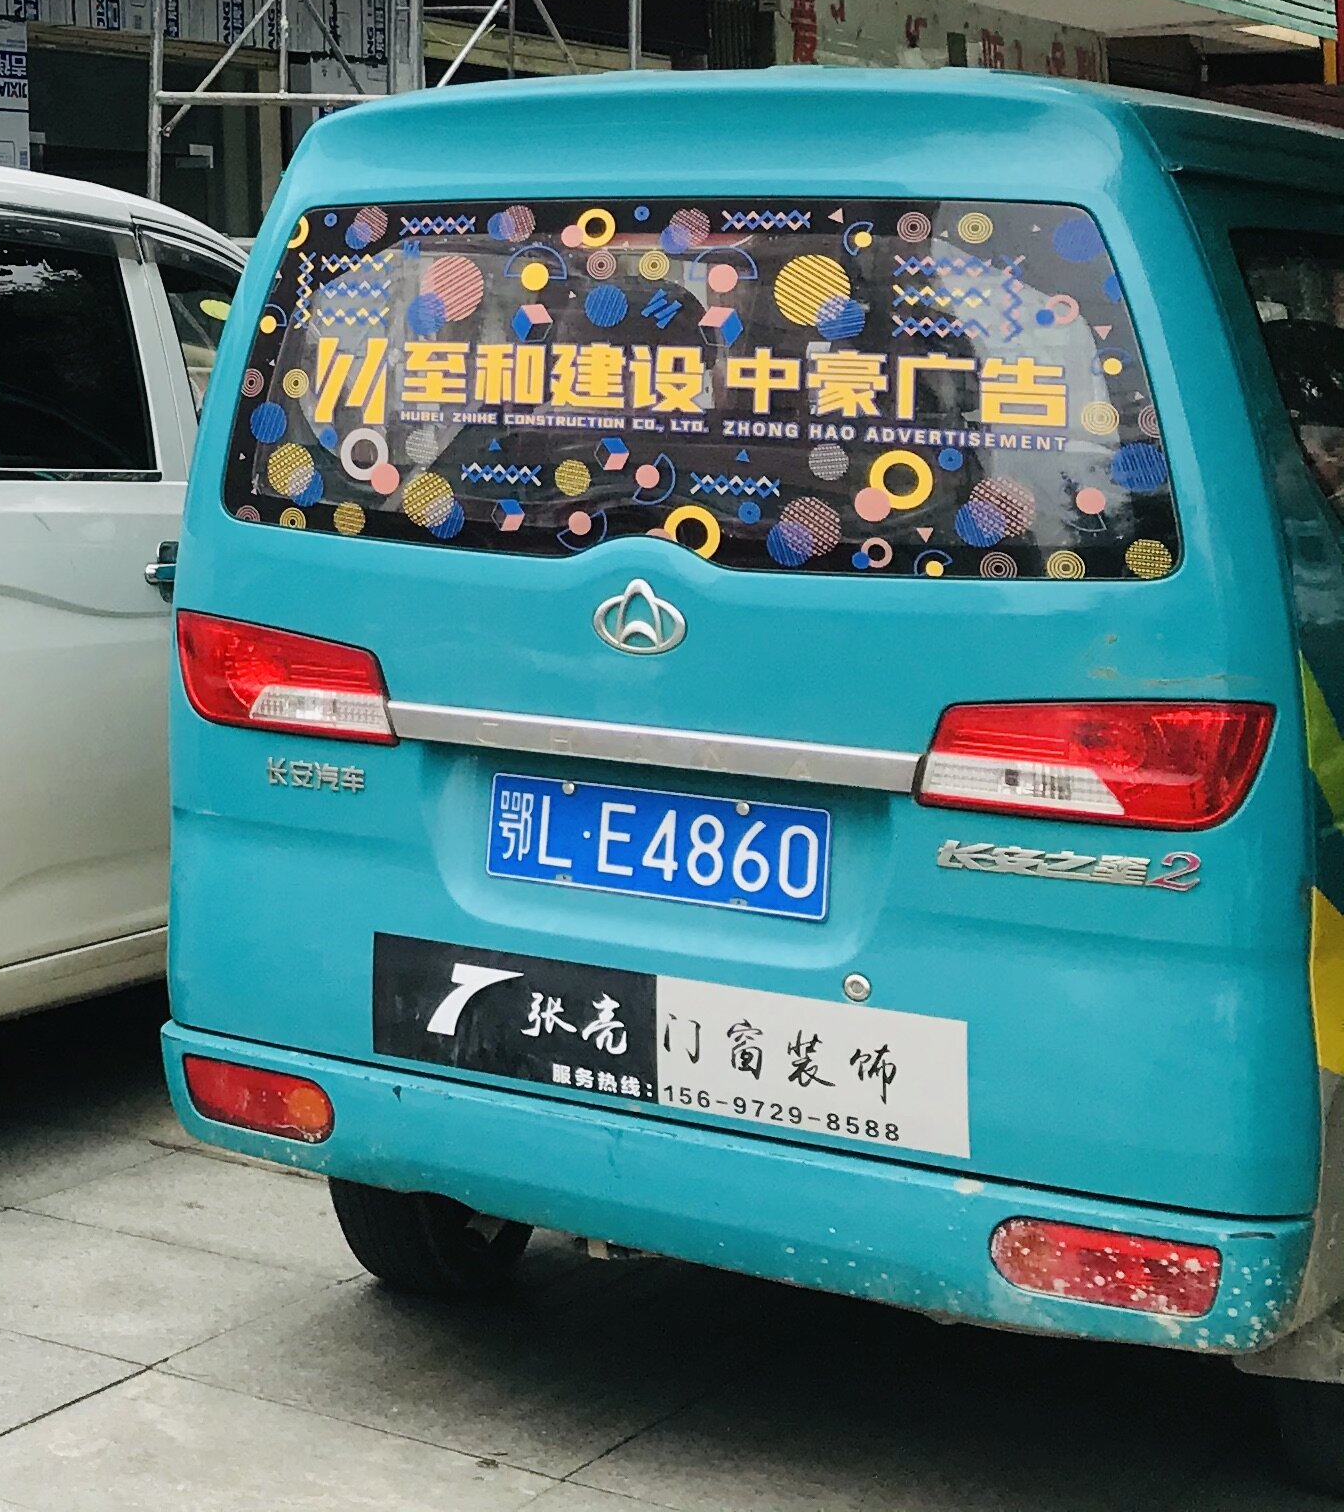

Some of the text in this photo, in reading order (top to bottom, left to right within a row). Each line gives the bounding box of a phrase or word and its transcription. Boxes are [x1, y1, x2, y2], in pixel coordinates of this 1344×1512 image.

[400, 341, 1067, 427] 至和建设 中豪广告
[400, 410, 444, 423] HUBEI
[452, 411, 497, 426] ZHIHE
[504, 413, 626, 430] CONSTRUCTION
[722, 419, 1067, 451] ZHONG HAO ADVERTISEMENT
[265, 756, 366, 794] 长安汽车
[520, 991, 629, 1056] 张亮
[662, 1013, 898, 1106] 门窗装饰
[663, 1084, 901, 1143] 156-9729-8588
